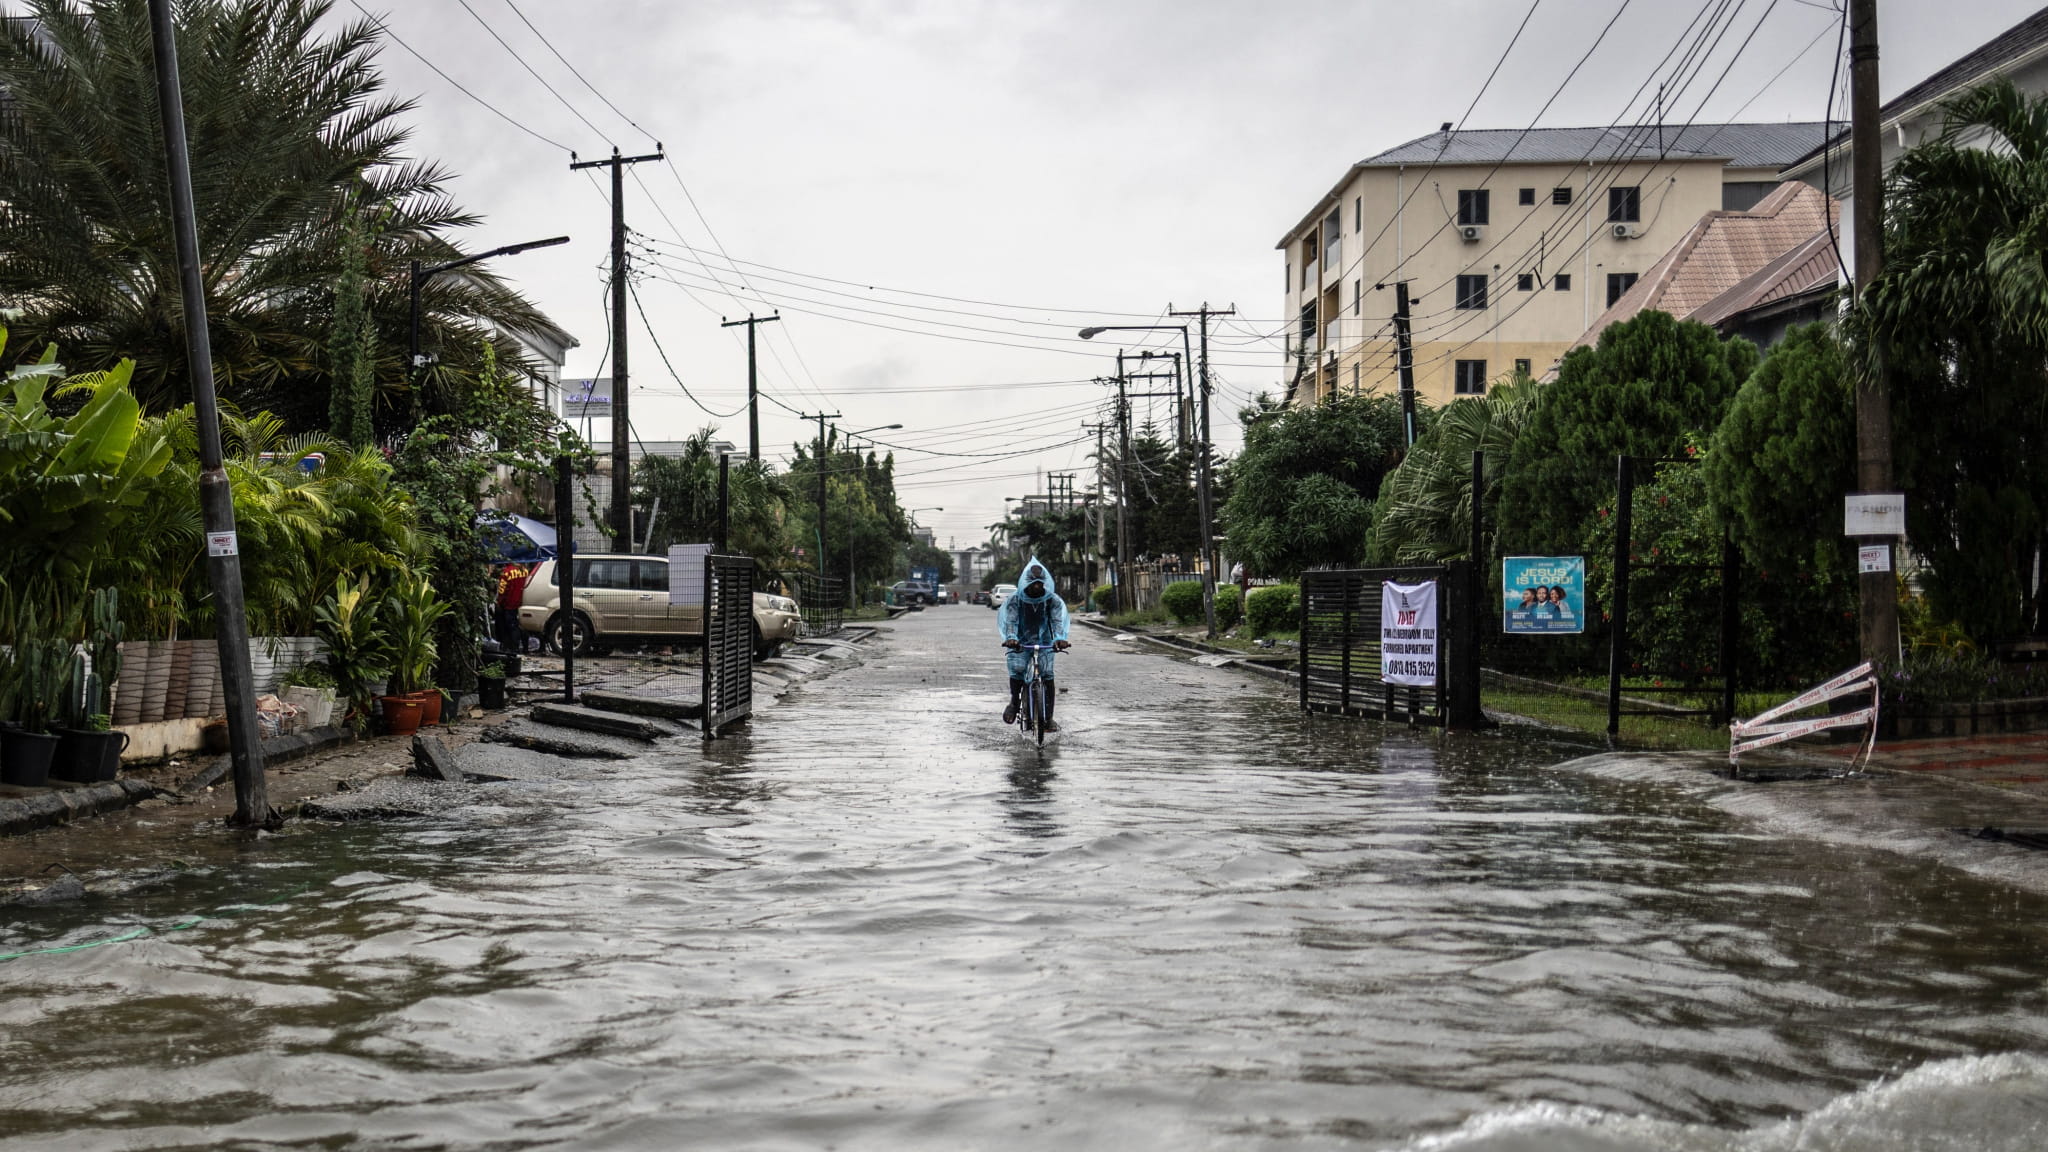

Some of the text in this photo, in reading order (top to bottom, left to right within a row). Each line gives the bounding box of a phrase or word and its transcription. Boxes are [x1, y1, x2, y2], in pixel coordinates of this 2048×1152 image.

[1848, 504, 1902, 513] FASHION
[1520, 567, 1567, 577] JESUS
[1516, 576, 1574, 585] IS LORD!
[1423, 629, 1435, 640] FULLY
[1405, 644, 1434, 655] APARTMENT
[1418, 661, 1435, 677] 3522
